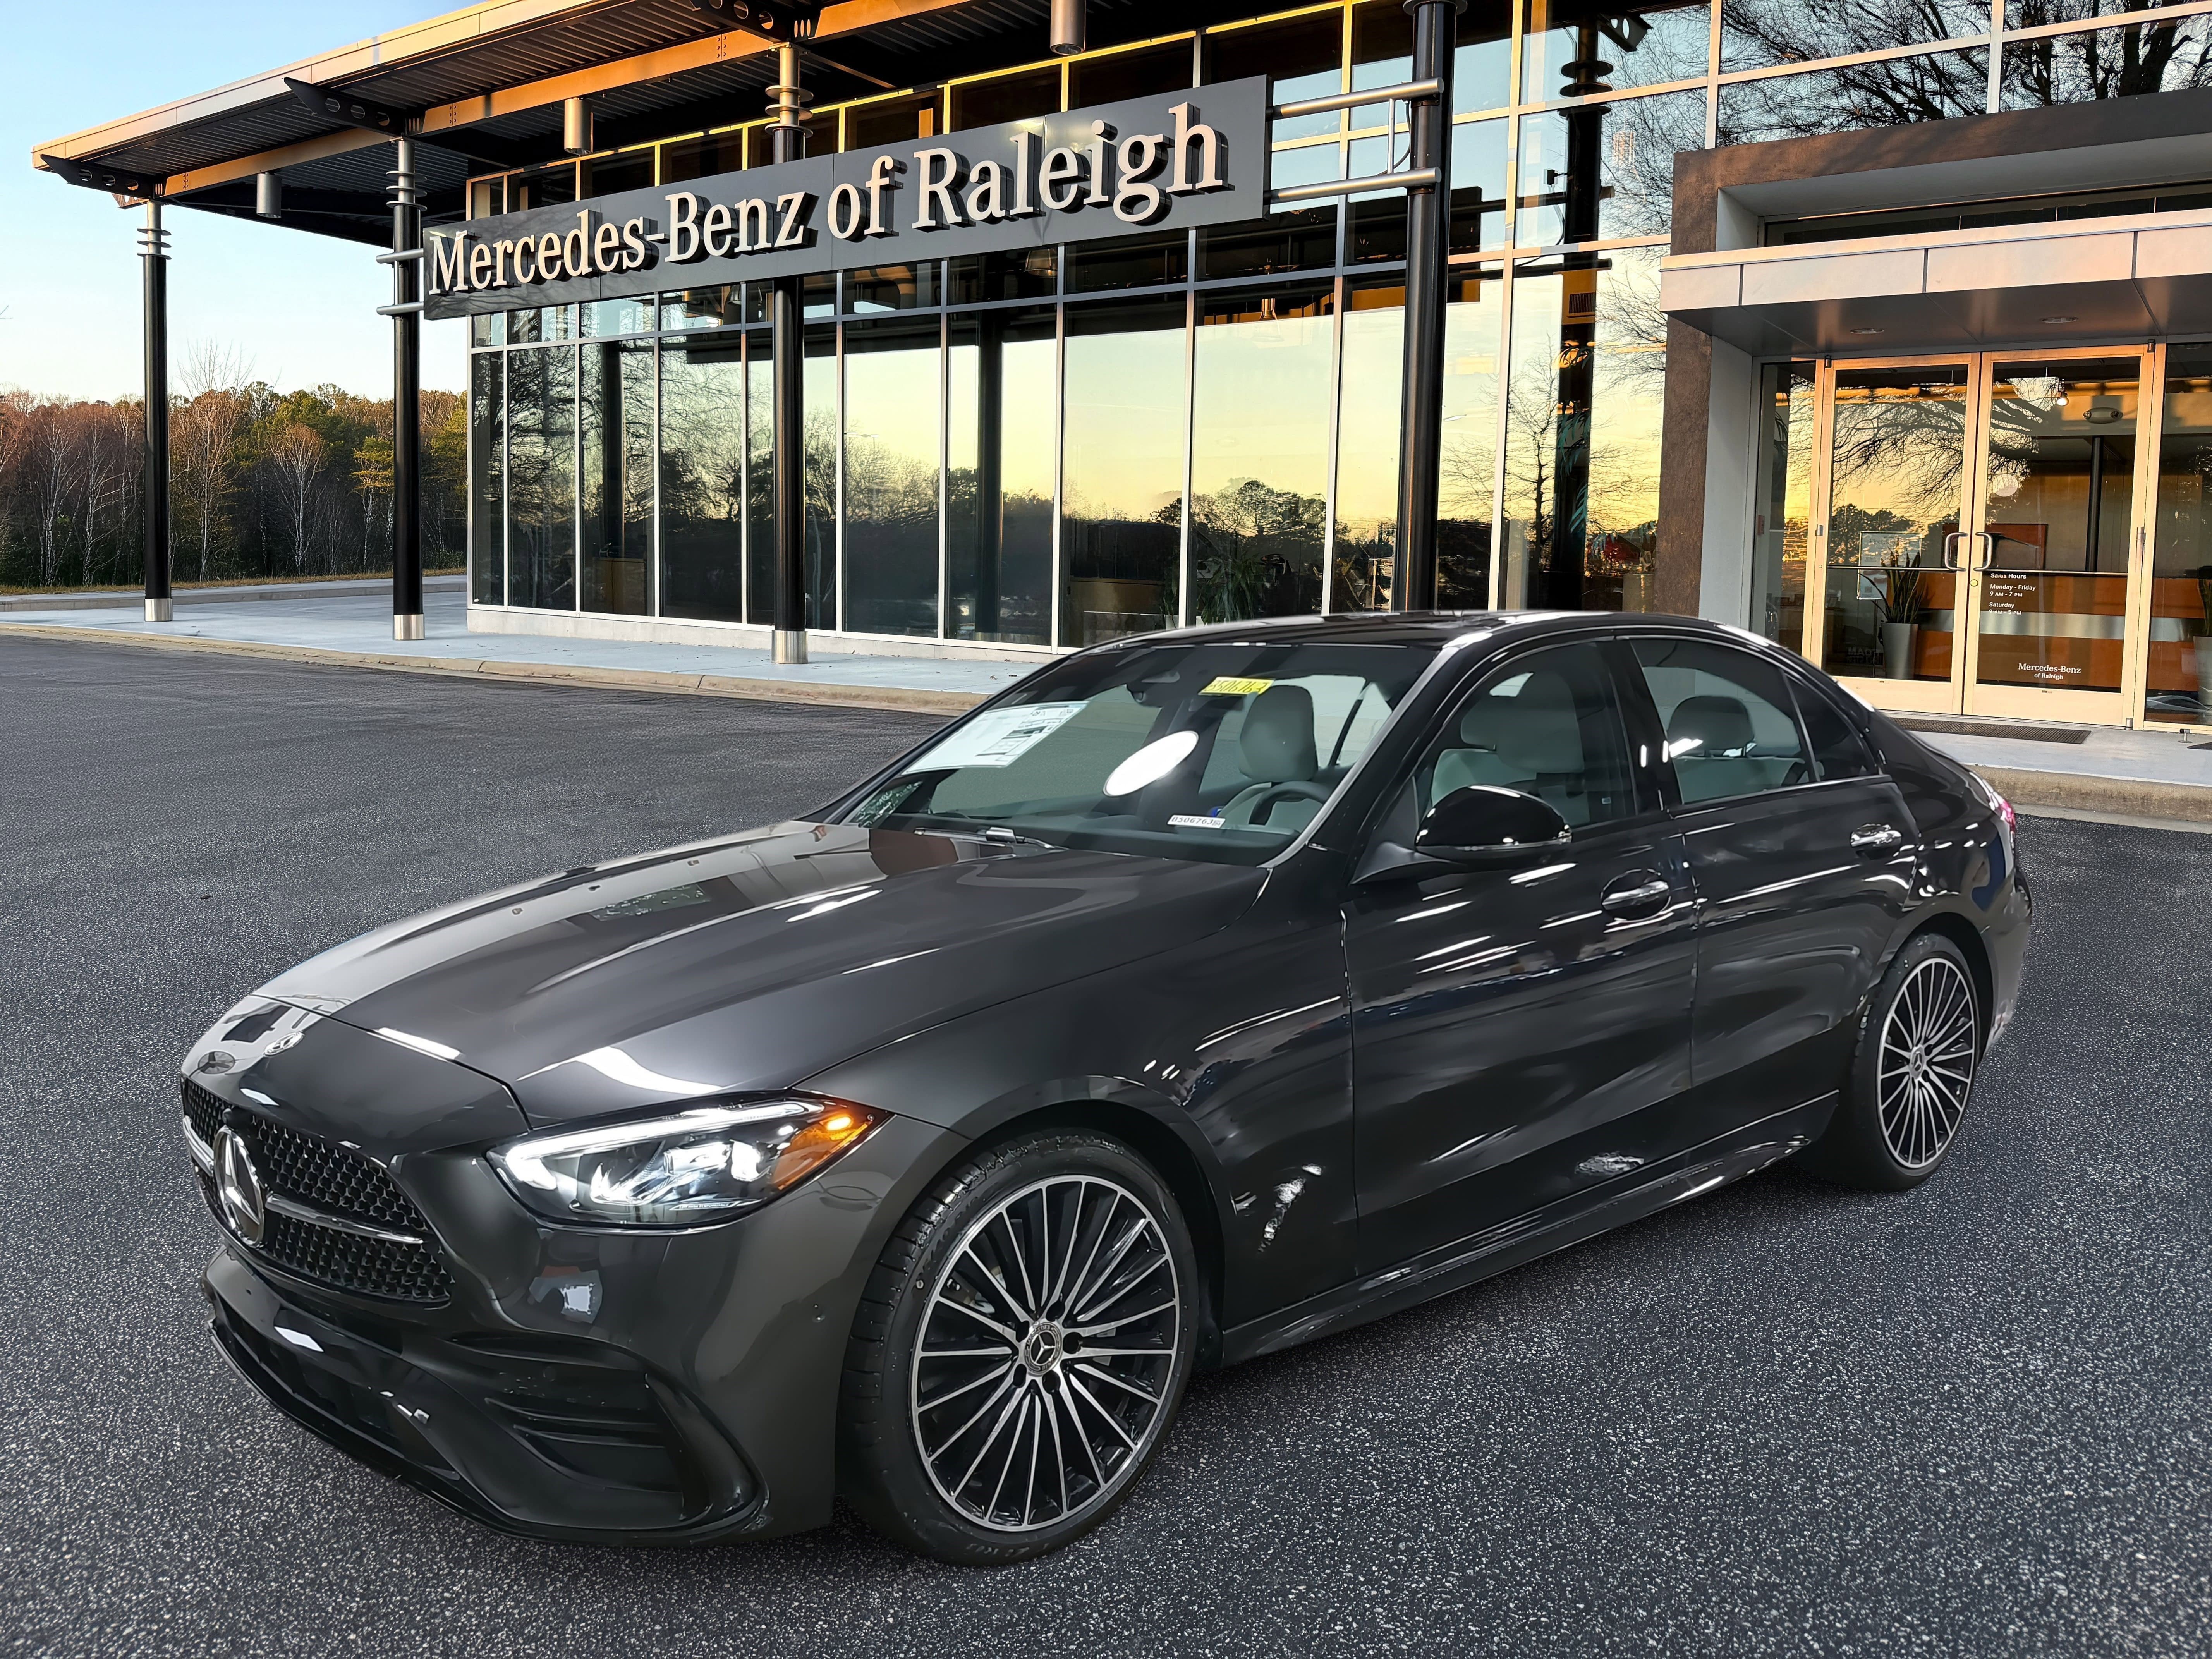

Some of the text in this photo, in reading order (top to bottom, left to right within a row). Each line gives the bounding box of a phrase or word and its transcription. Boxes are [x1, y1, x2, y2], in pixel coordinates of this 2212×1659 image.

[429, 101, 1224, 295] Mercedes-Benz of Raleigh
[2018, 663, 2081, 674] Mercedes-Benz
